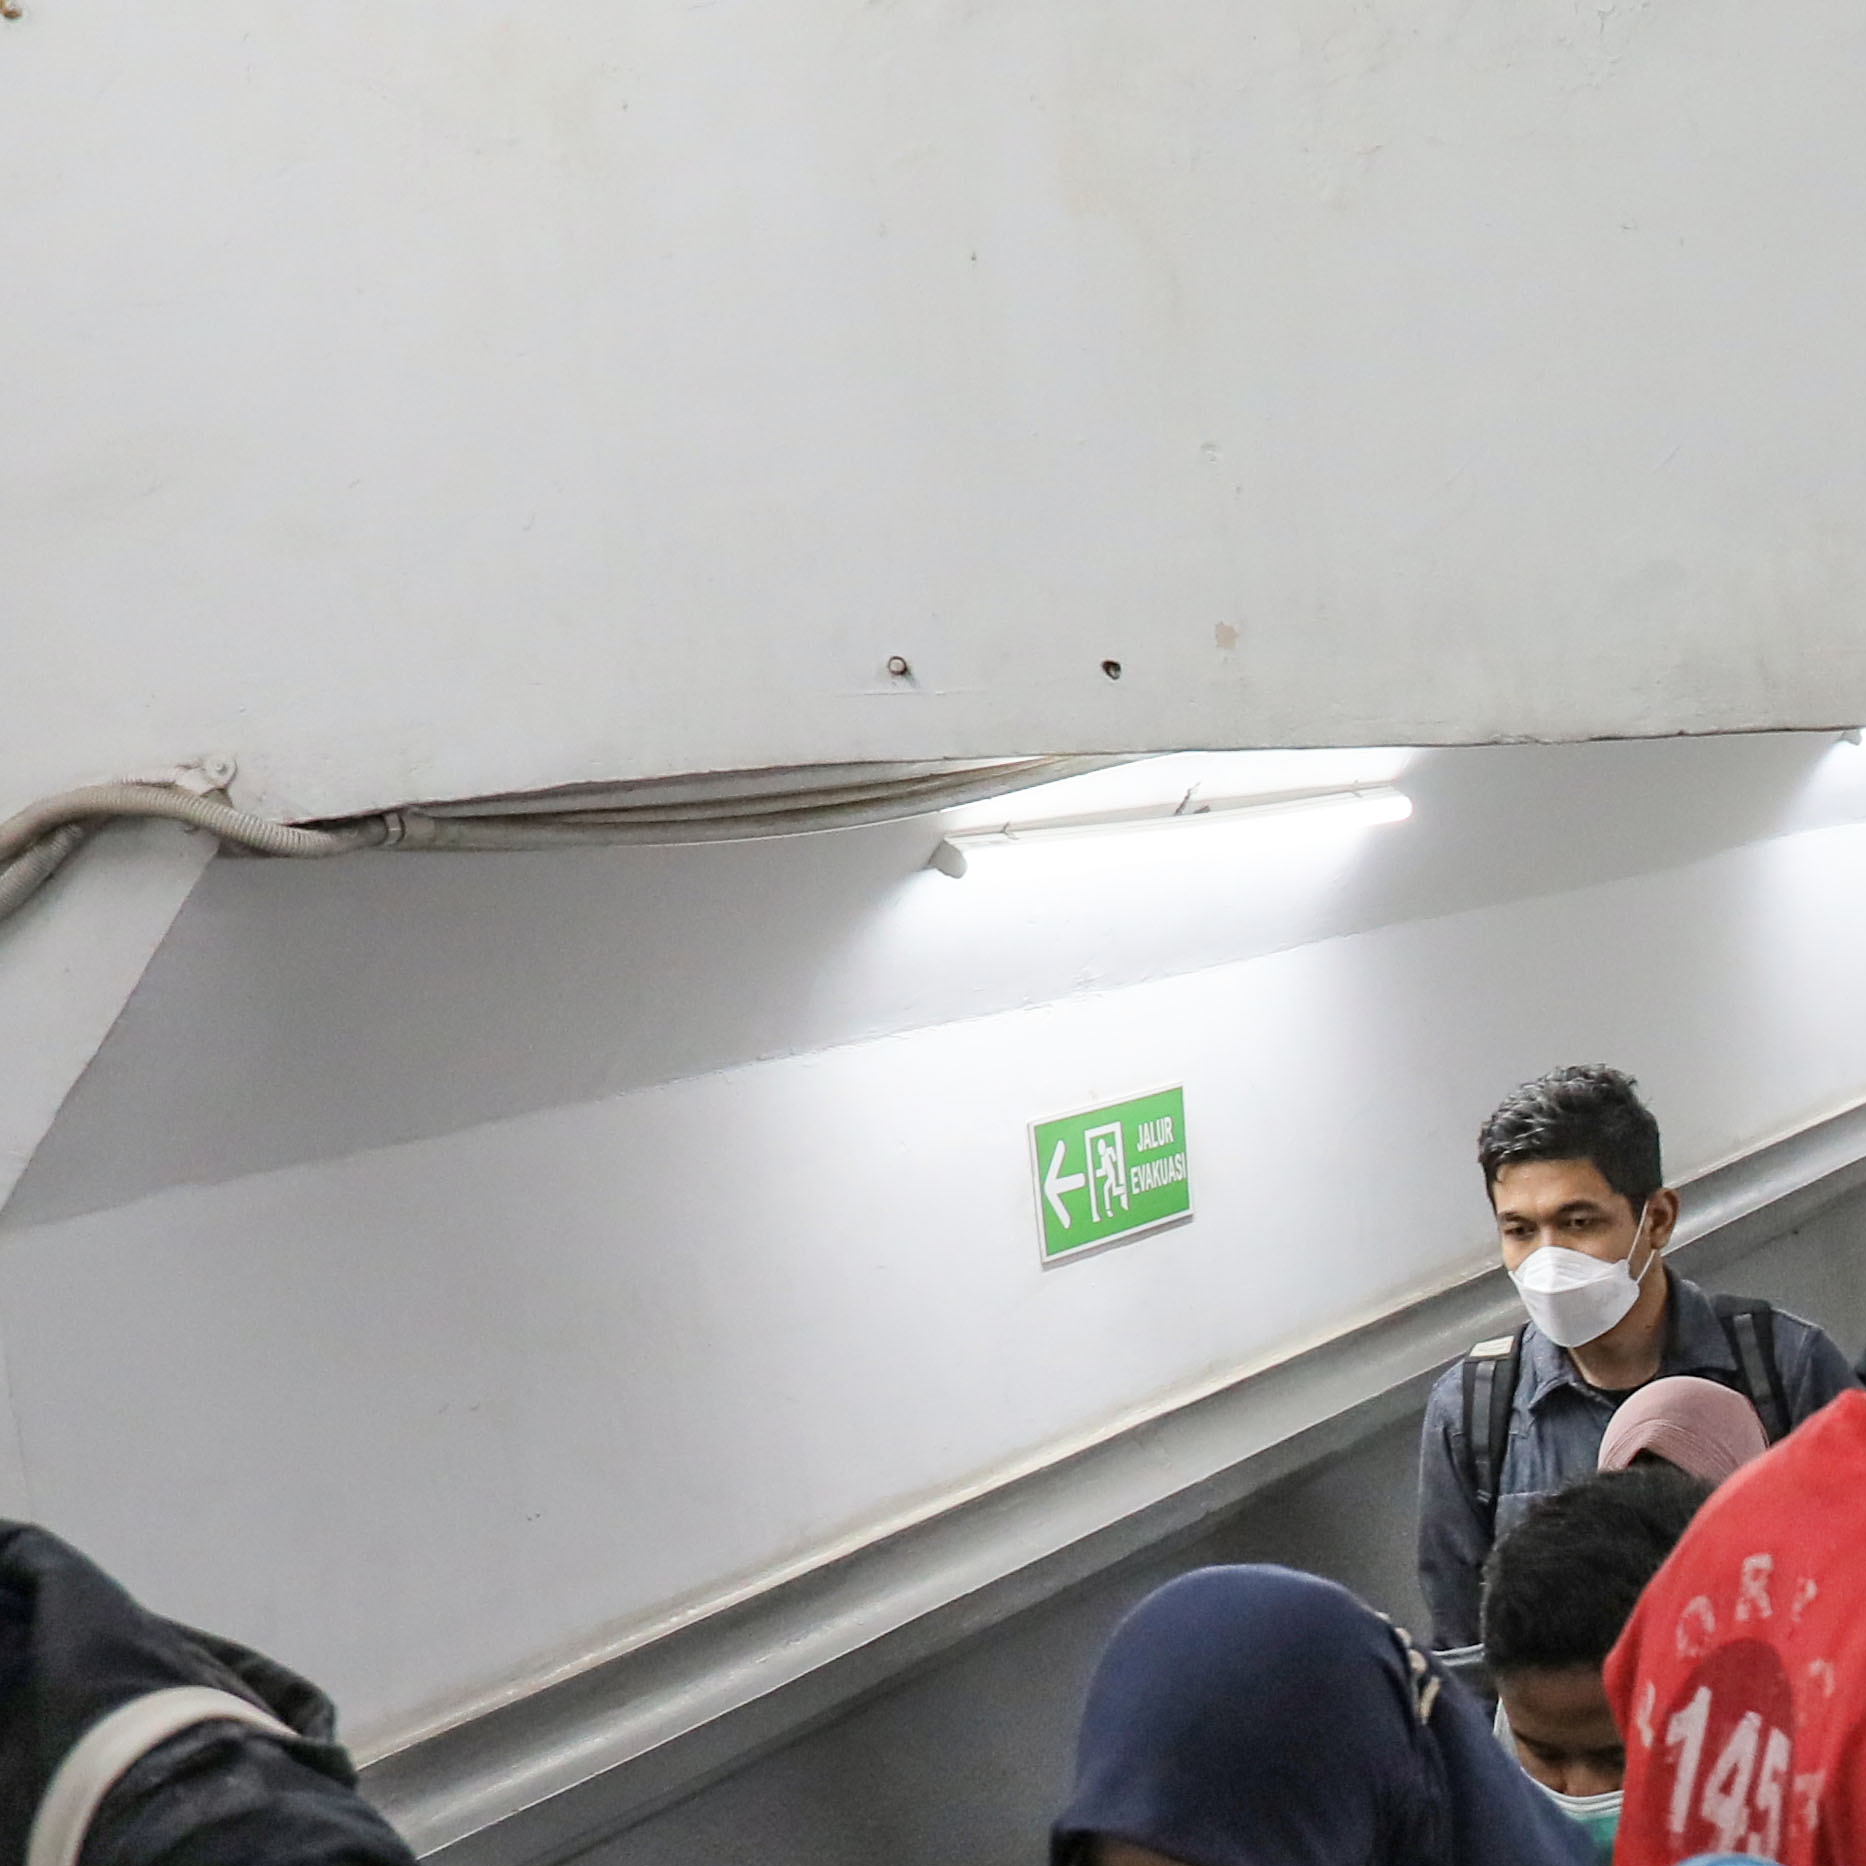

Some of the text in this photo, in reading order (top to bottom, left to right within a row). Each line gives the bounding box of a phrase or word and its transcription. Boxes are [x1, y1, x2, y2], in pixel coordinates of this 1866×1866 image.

[1137, 1116, 1174, 1152] JALUR
[1130, 1152, 1186, 1195] EVAKUASI
[1666, 1686, 1791, 1862] 145
